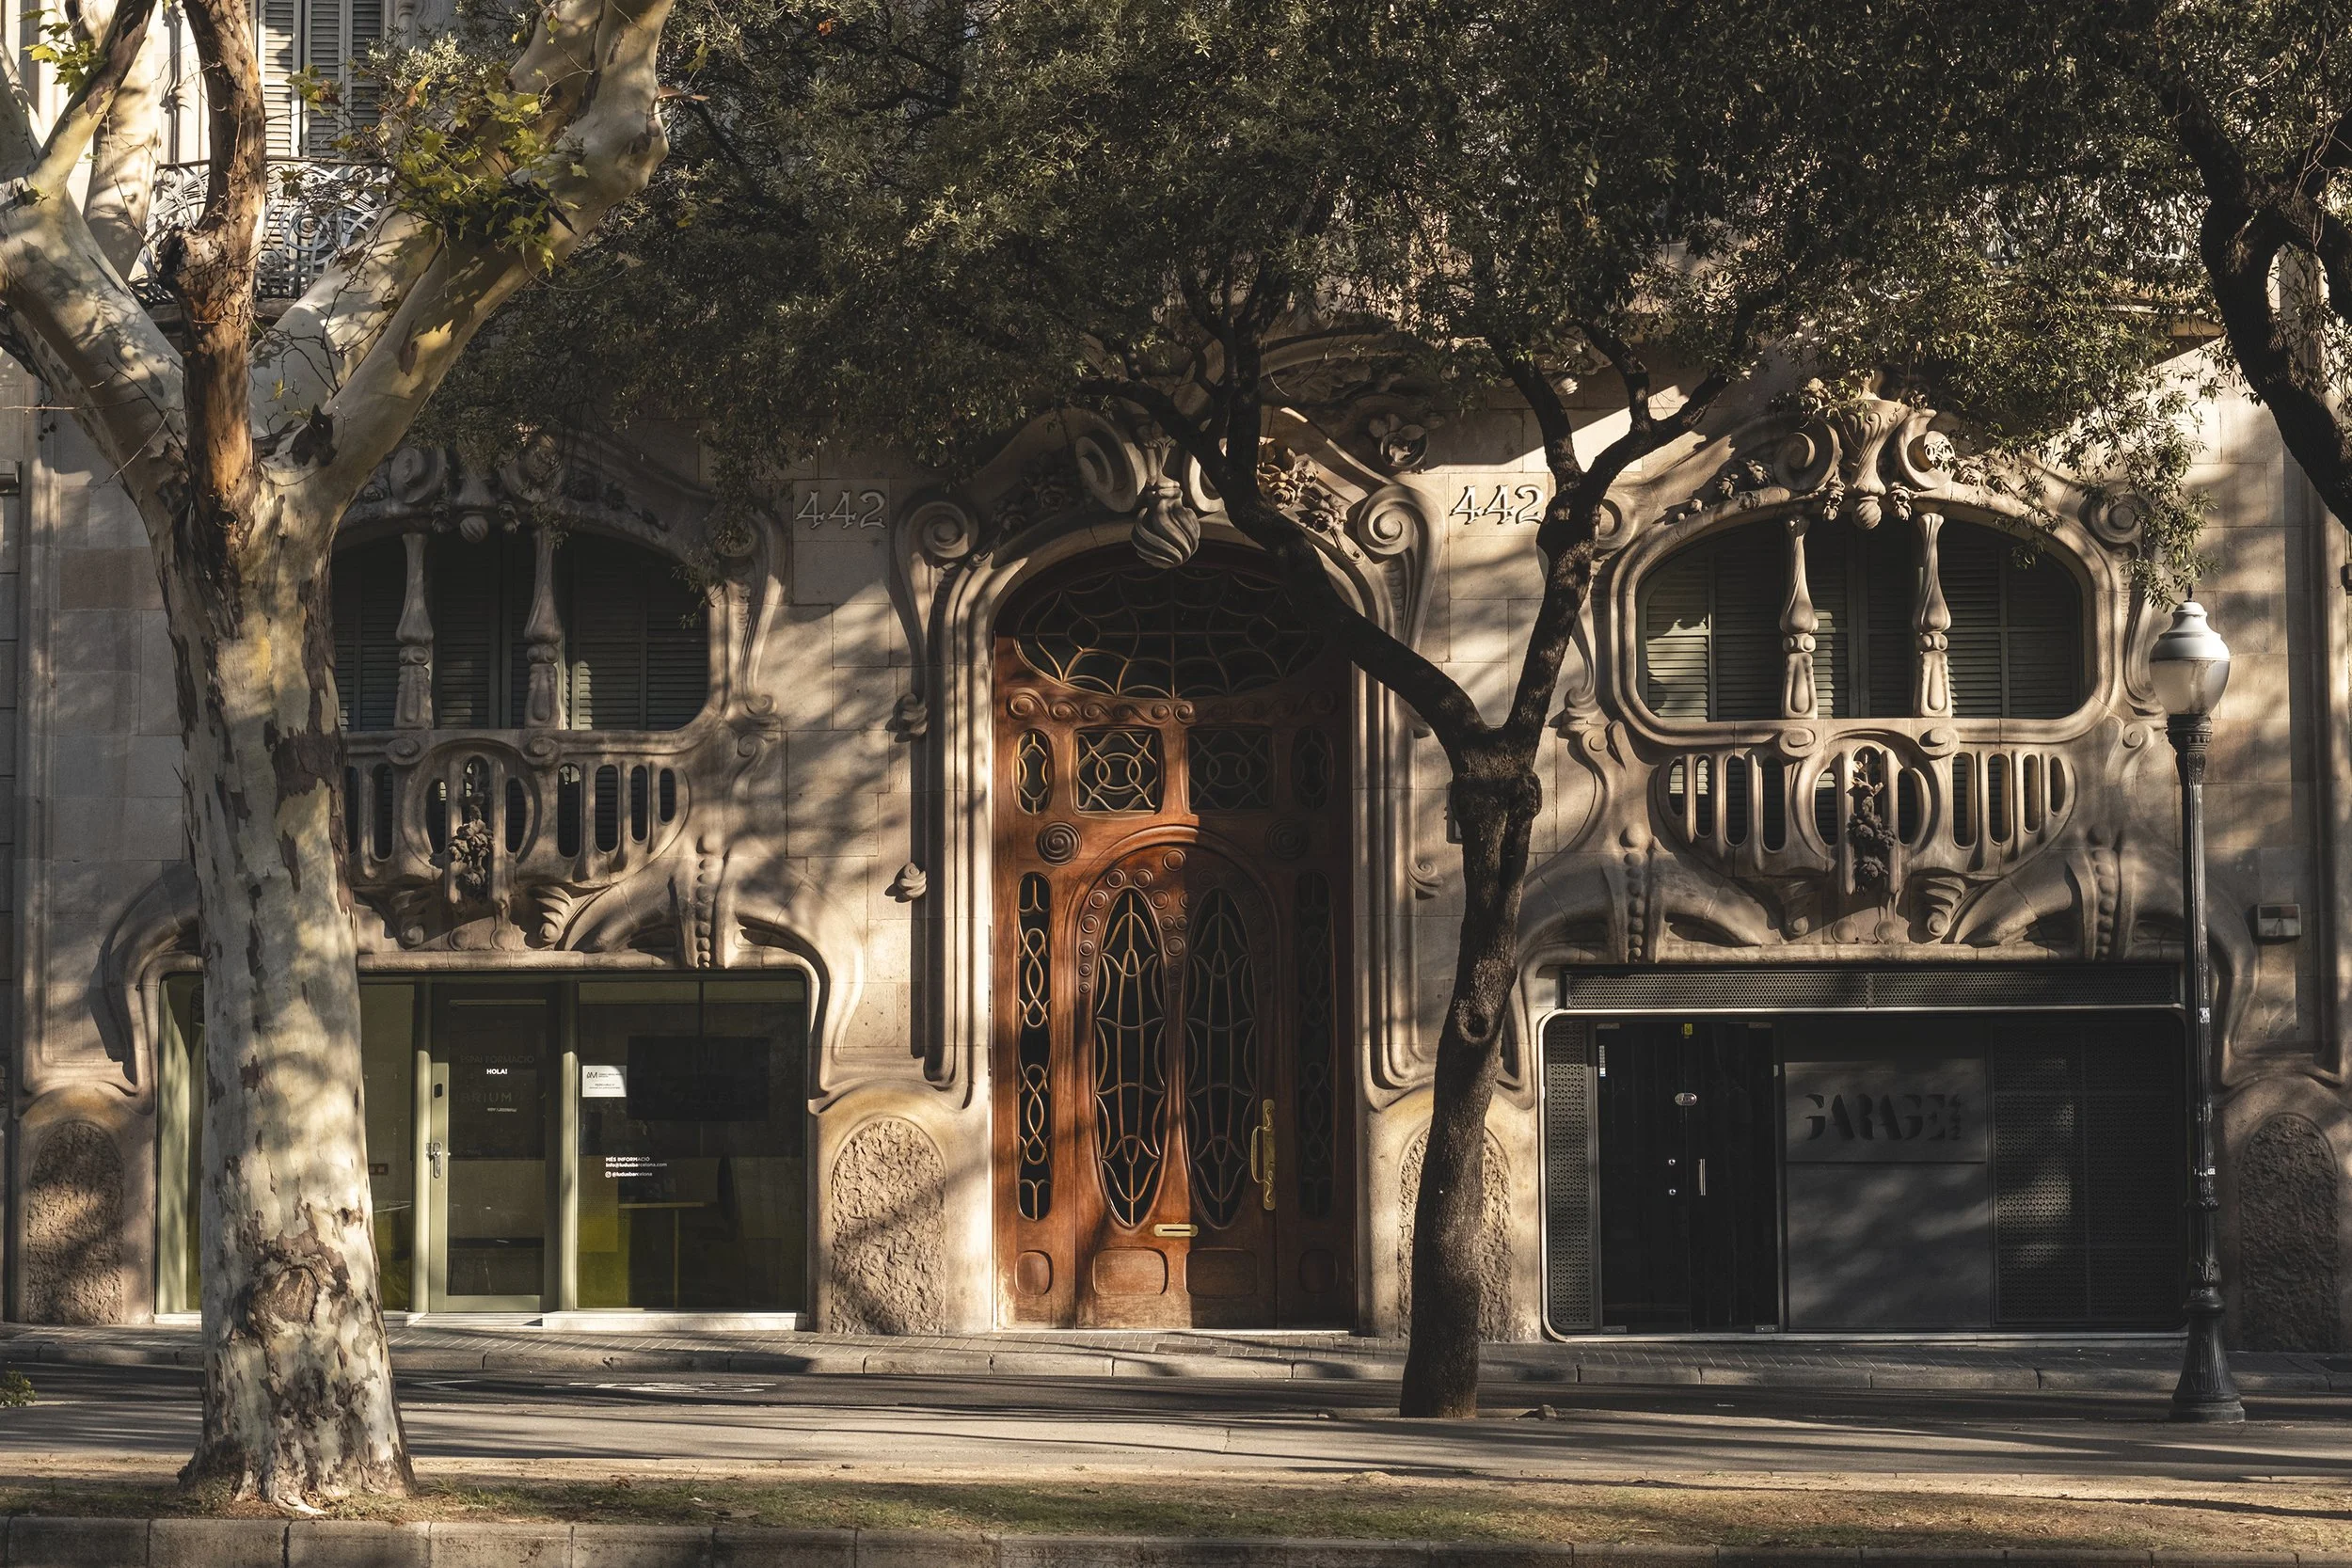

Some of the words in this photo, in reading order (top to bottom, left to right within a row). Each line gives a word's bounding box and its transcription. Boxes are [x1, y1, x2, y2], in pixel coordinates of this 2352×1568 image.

[796, 490, 885, 529] 442
[1449, 483, 1544, 525] 442
[1805, 1093, 1946, 1140] GARAGE
